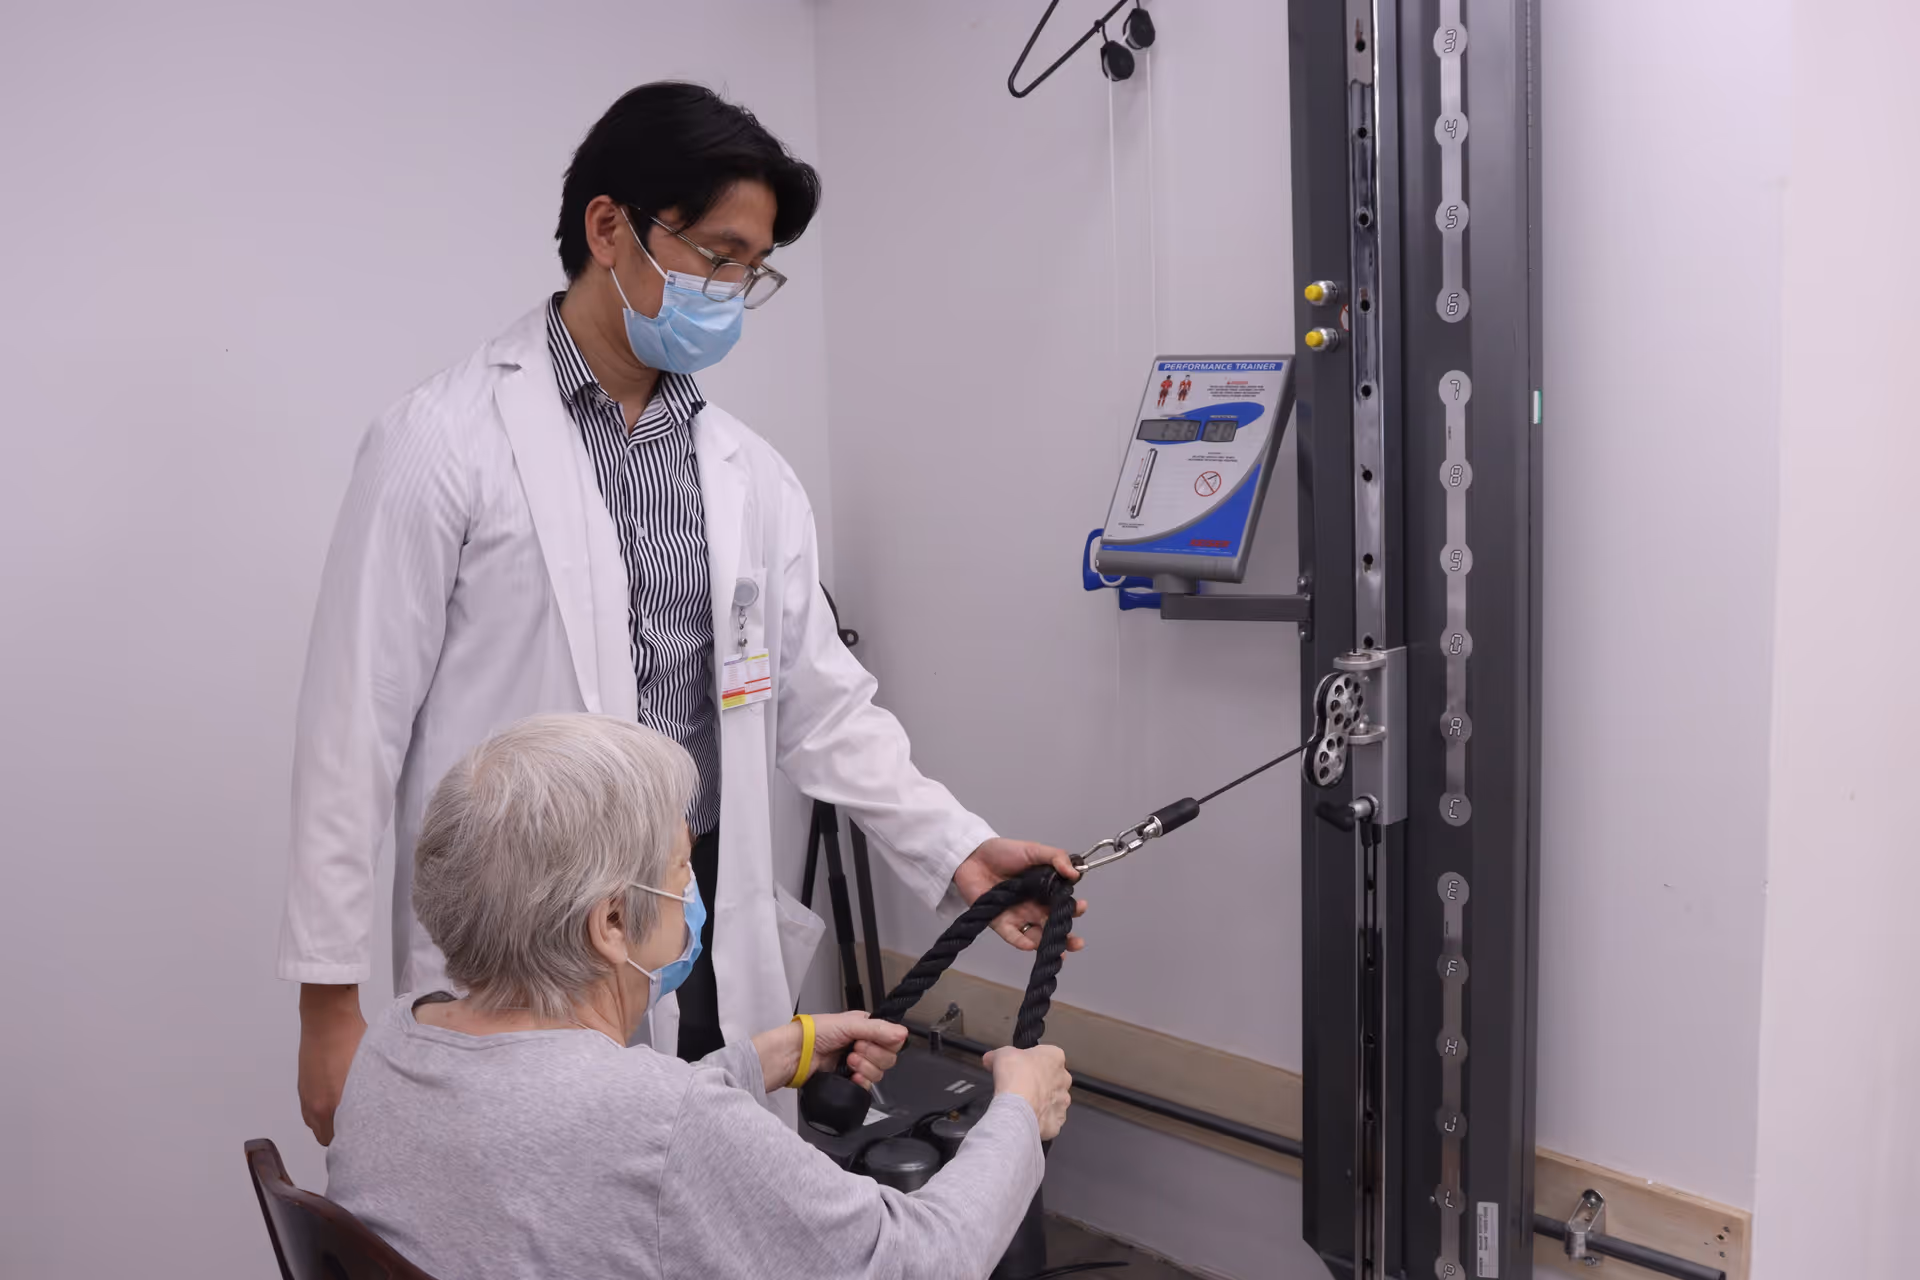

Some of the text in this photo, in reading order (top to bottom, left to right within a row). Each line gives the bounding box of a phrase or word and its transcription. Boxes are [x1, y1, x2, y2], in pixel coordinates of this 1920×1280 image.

[1444, 29, 1457, 53] 3
[1444, 119, 1458, 139] 4
[1446, 205, 1458, 229] 5
[1446, 292, 1459, 316] 6
[1163, 363, 1277, 371] PERFORMANCE TRAINER
[1450, 379, 1460, 401] 7
[1449, 464, 1463, 487] 8
[1449, 549, 1463, 571] 9
[1449, 717, 1463, 736] A
[1448, 798, 1461, 819] C
[1446, 879, 1460, 900] E
[1446, 959, 1459, 977] F
[1445, 1038, 1459, 1056] H
[1444, 1189, 1455, 1208] L
